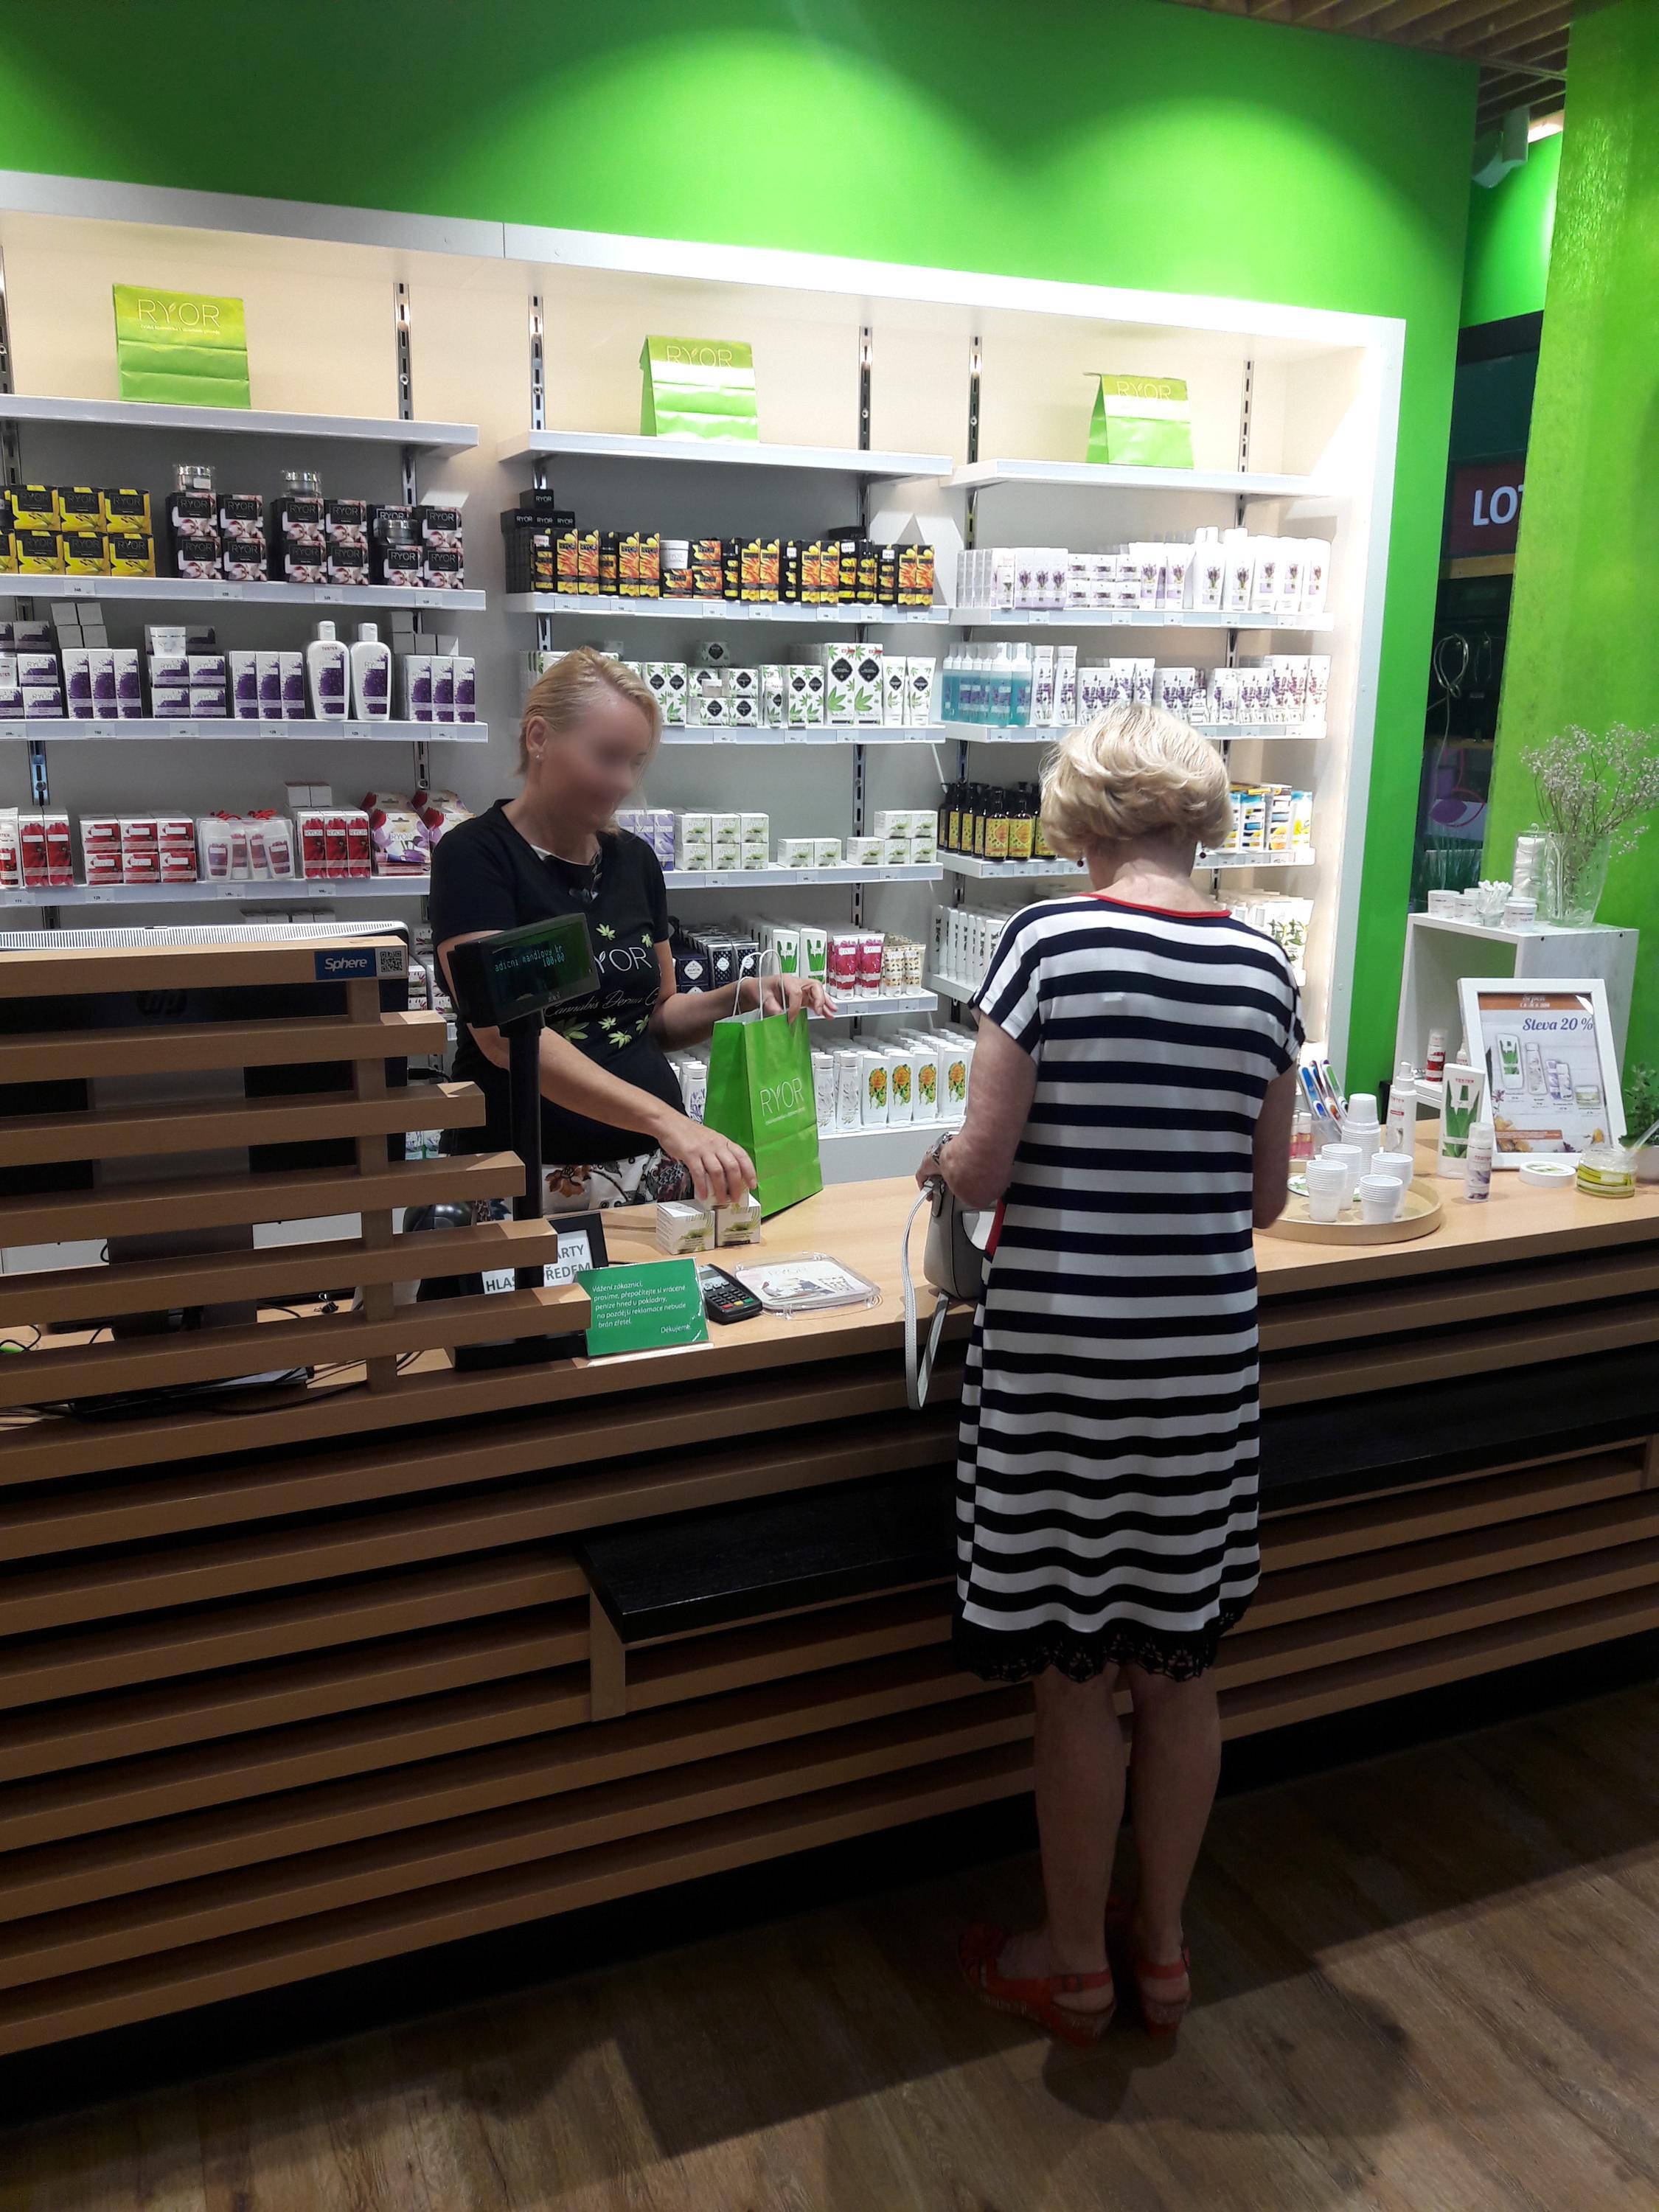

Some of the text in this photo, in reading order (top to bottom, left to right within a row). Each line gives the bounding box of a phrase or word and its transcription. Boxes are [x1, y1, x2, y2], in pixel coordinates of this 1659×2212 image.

[138, 299, 220, 328] RYOR
[667, 345, 732, 367] RYOR
[1116, 380, 1171, 400] RYOR
[180, 499, 209, 509] RYOR
[227, 501, 254, 511] RYOR
[288, 504, 316, 513] RYOR
[1472, 484, 1523, 526] LO
[333, 506, 358, 516] RYOR
[429, 512, 455, 522] RYOR
[117, 541, 146, 550] RYOR
[185, 541, 213, 551] RYOR
[232, 543, 258, 554] RYOR
[390, 552, 416, 562] RYOR
[431, 553, 456, 563] RYOR
[324, 956, 367, 972] Sphere
[593, 947, 653, 974] YOR
[1523, 1017, 1593, 1031] Sleva 20 %
[759, 1077, 804, 1117] RYOR
[545, 1262, 591, 1281] ŘEDEM
[616, 1298, 632, 1308] hned
[632, 1305, 664, 1315] reklamace
[664, 1301, 686, 1310] nebude
